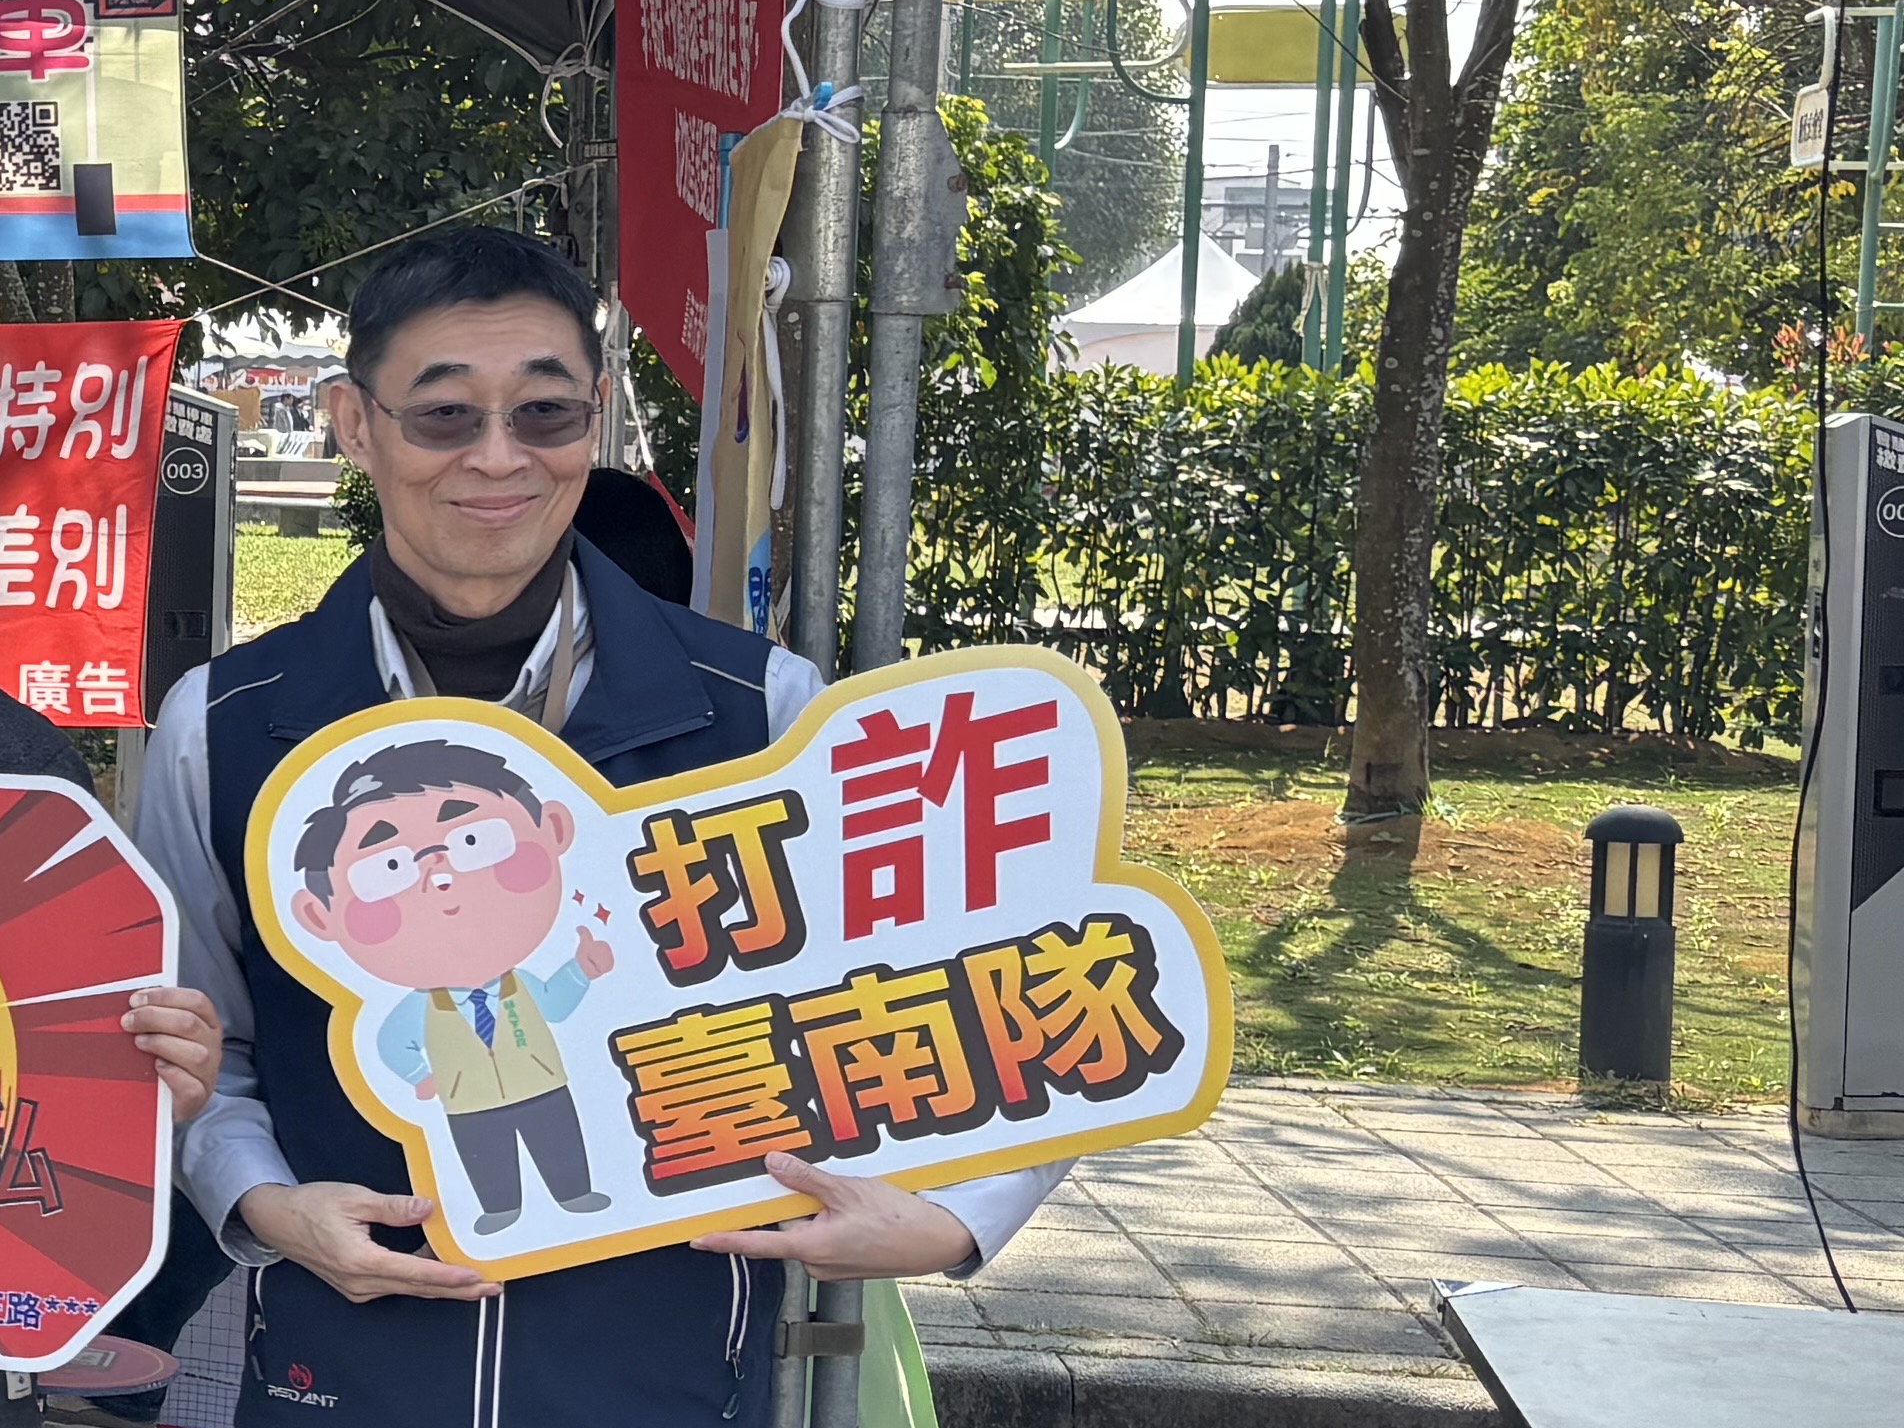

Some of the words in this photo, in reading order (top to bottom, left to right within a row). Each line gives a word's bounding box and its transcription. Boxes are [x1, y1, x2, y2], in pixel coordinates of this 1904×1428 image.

[166, 463, 204, 479] 003
[18, 660, 130, 715] 廣告
[630, 691, 1060, 980] 打詐
[612, 919, 1168, 1184] 臺南隊
